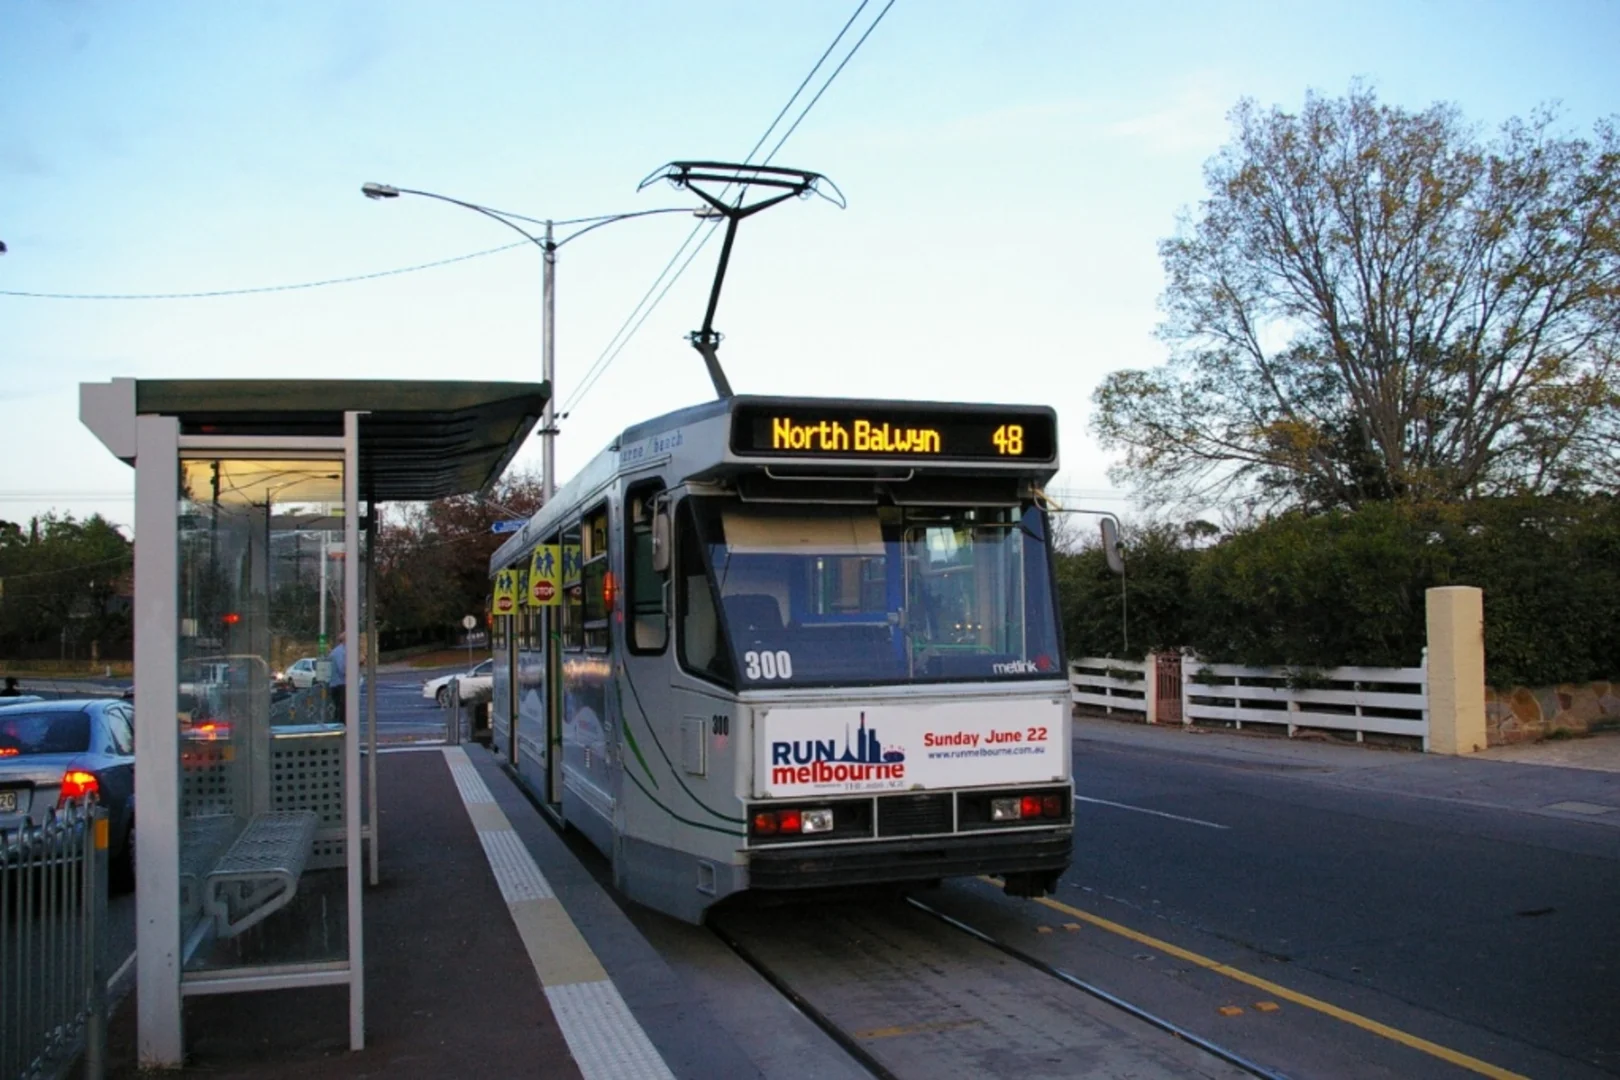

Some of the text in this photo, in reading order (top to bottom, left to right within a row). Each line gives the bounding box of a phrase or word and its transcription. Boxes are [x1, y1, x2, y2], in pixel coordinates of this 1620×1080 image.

[772, 417, 1024, 455] North Balwyn 48
[533, 586, 555, 597] STOP
[744, 650, 793, 680] 300
[712, 714, 729, 736] 300
[924, 727, 1047, 747] Sunday June 22
[772, 739, 835, 765] RUN
[928, 746, 1045, 759] www.runmelbourne.com.au
[772, 760, 905, 785] melbourne
